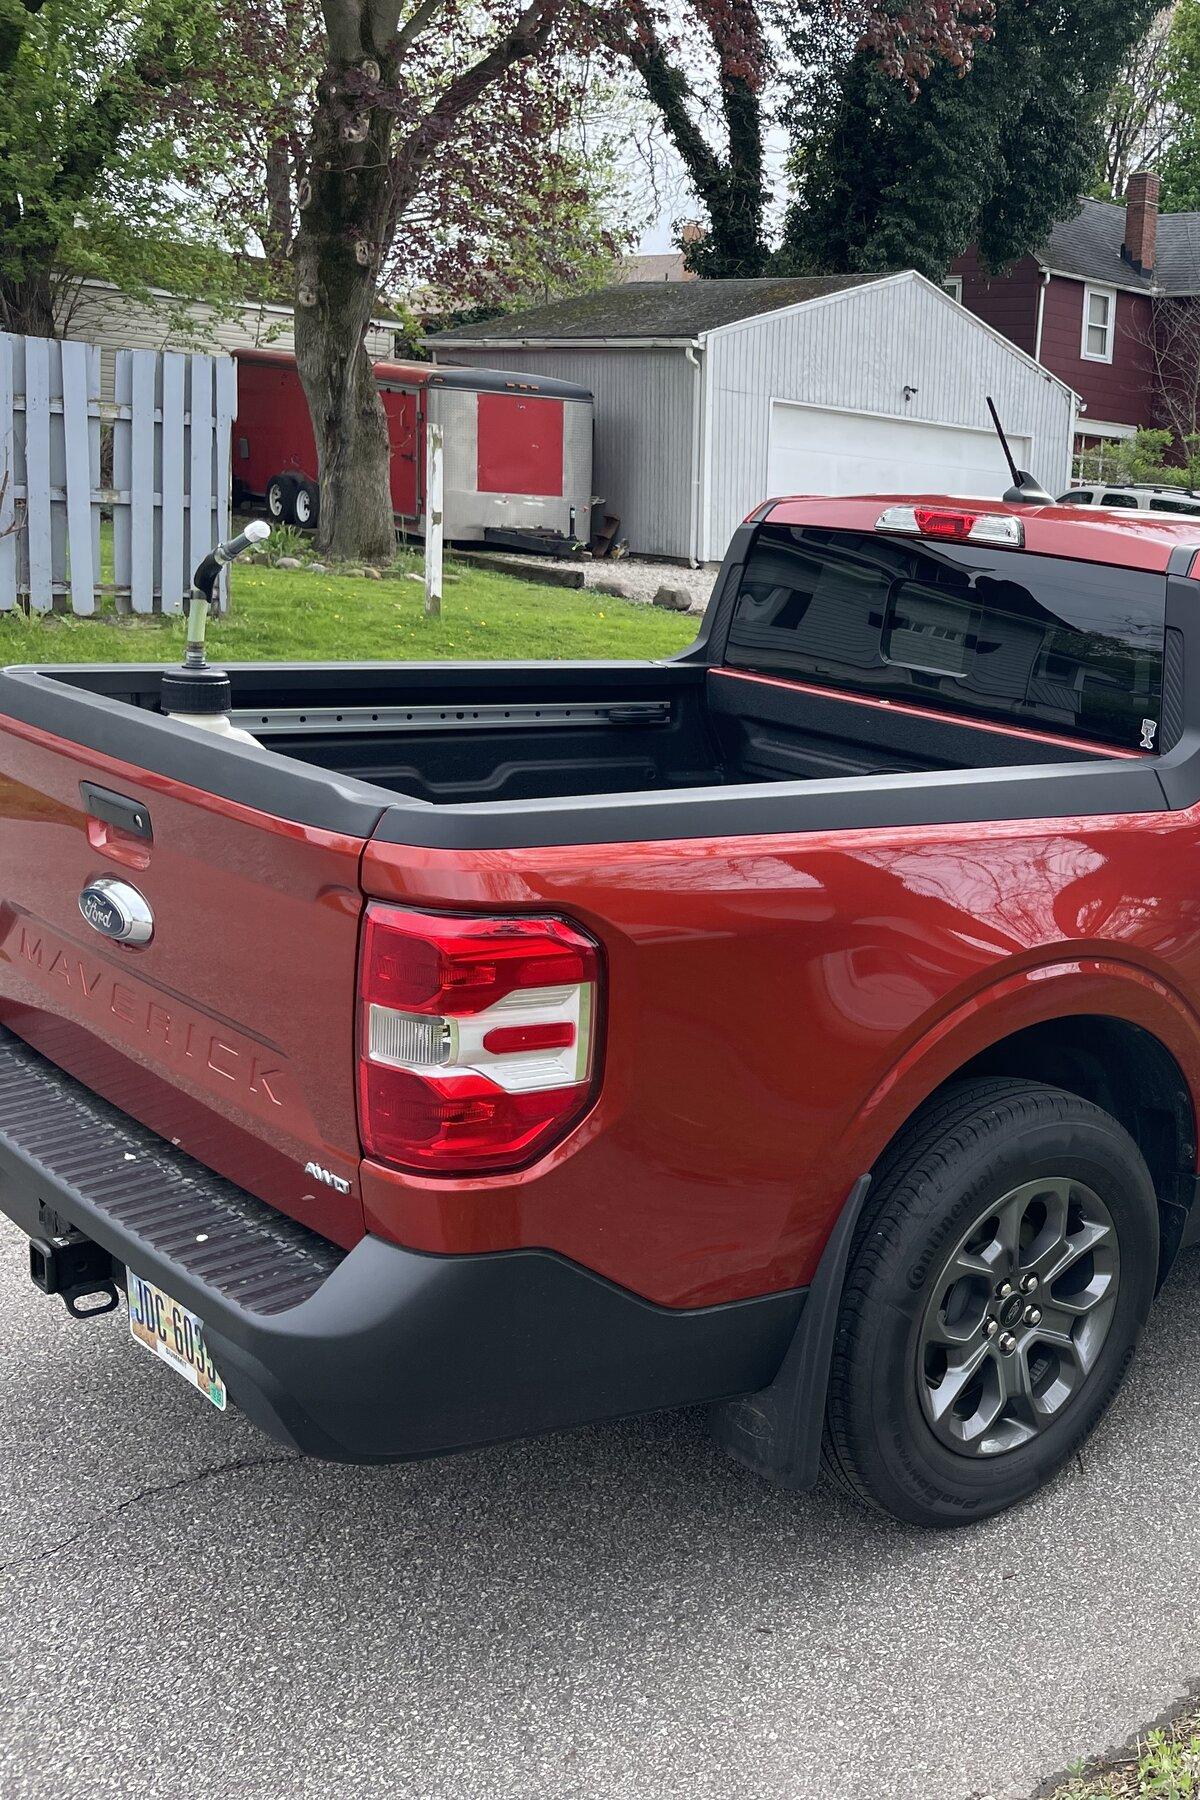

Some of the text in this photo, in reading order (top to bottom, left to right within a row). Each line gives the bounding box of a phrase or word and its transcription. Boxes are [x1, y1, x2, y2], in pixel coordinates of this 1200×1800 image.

[84, 894, 113, 928] Ford
[19, 927, 284, 1106] MAVERICK
[304, 1161, 351, 1195] AWD
[134, 1279, 168, 1342] JDC
